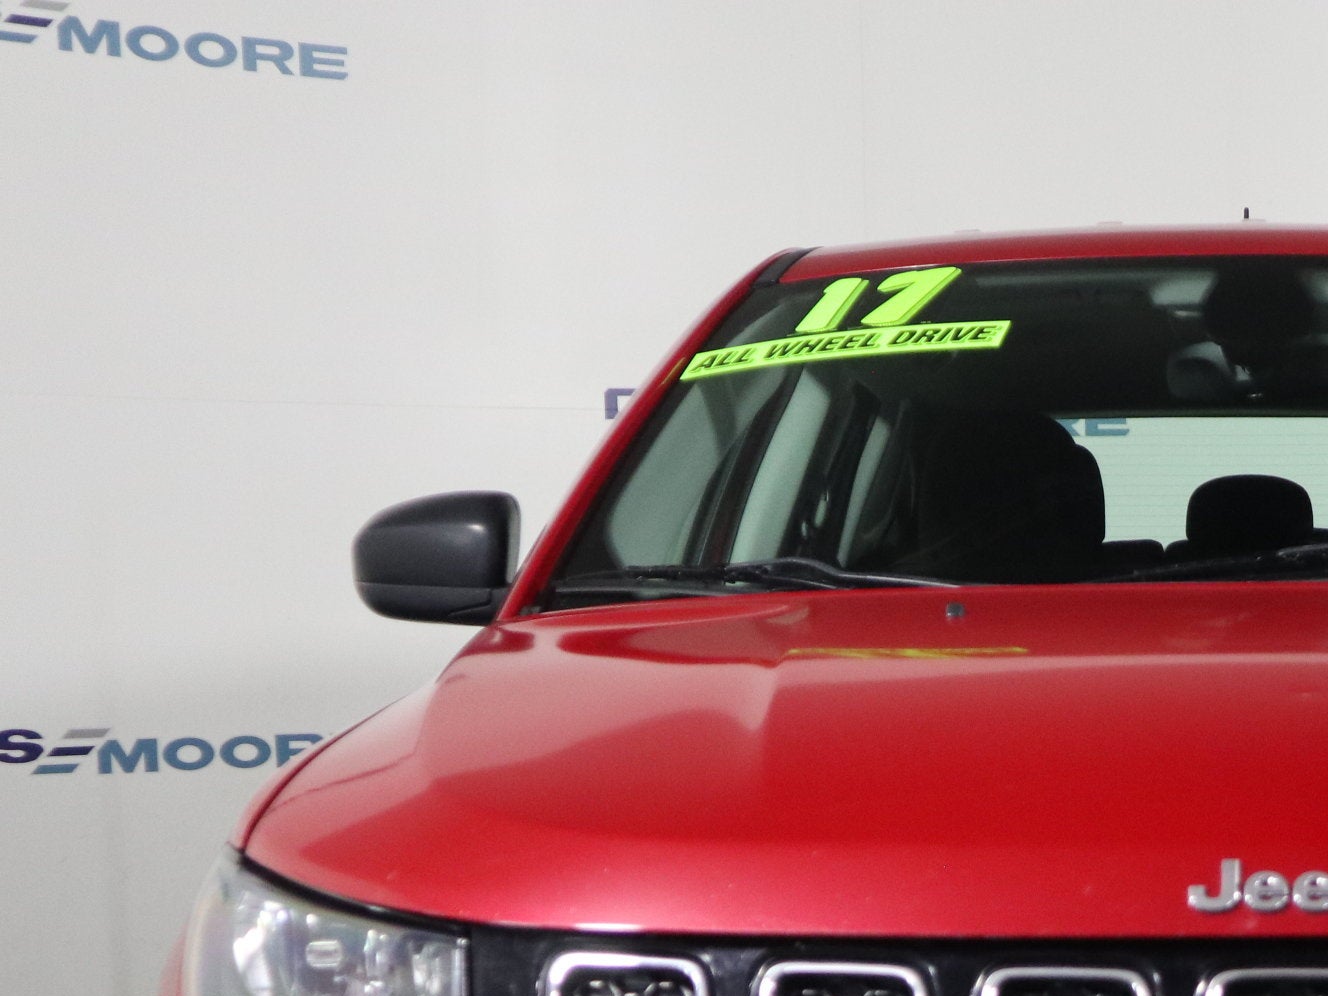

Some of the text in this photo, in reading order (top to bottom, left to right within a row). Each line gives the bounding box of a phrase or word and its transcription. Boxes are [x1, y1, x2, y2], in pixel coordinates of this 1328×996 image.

[57, 15, 348, 81] MOORE
[794, 266, 963, 333] 17
[692, 324, 996, 373] ALL WHEEL DRIVE
[97, 733, 324, 774] MOOR
